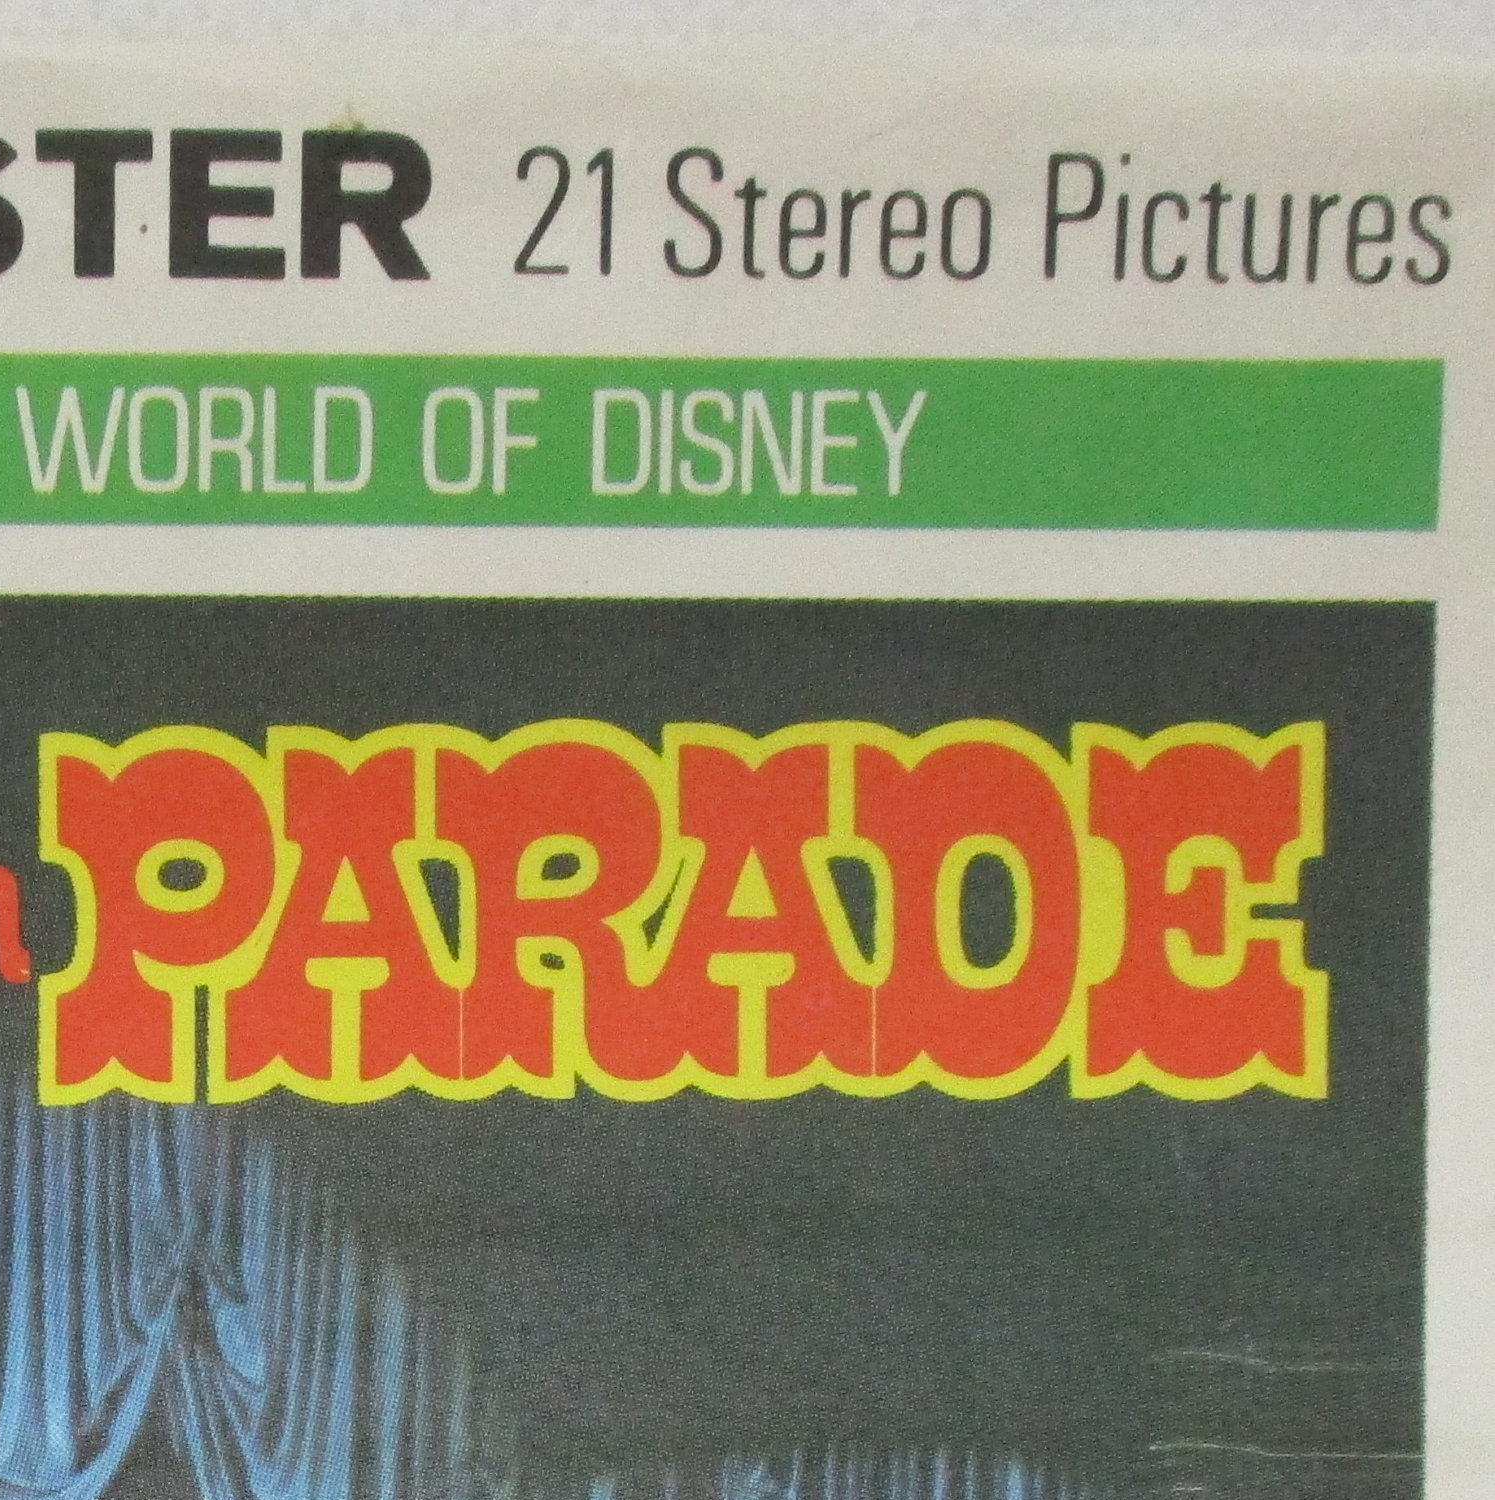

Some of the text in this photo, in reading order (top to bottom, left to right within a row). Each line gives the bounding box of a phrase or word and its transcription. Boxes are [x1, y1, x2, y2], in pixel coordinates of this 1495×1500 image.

[513, 145, 616, 277] 21
[663, 147, 993, 281] Stereo
[1043, 151, 1454, 286] Pictures
[15, 385, 373, 495] WORLD
[421, 388, 540, 496] OF
[589, 388, 929, 498] DISNEY
[38, 718, 1330, 1107] PARADE
